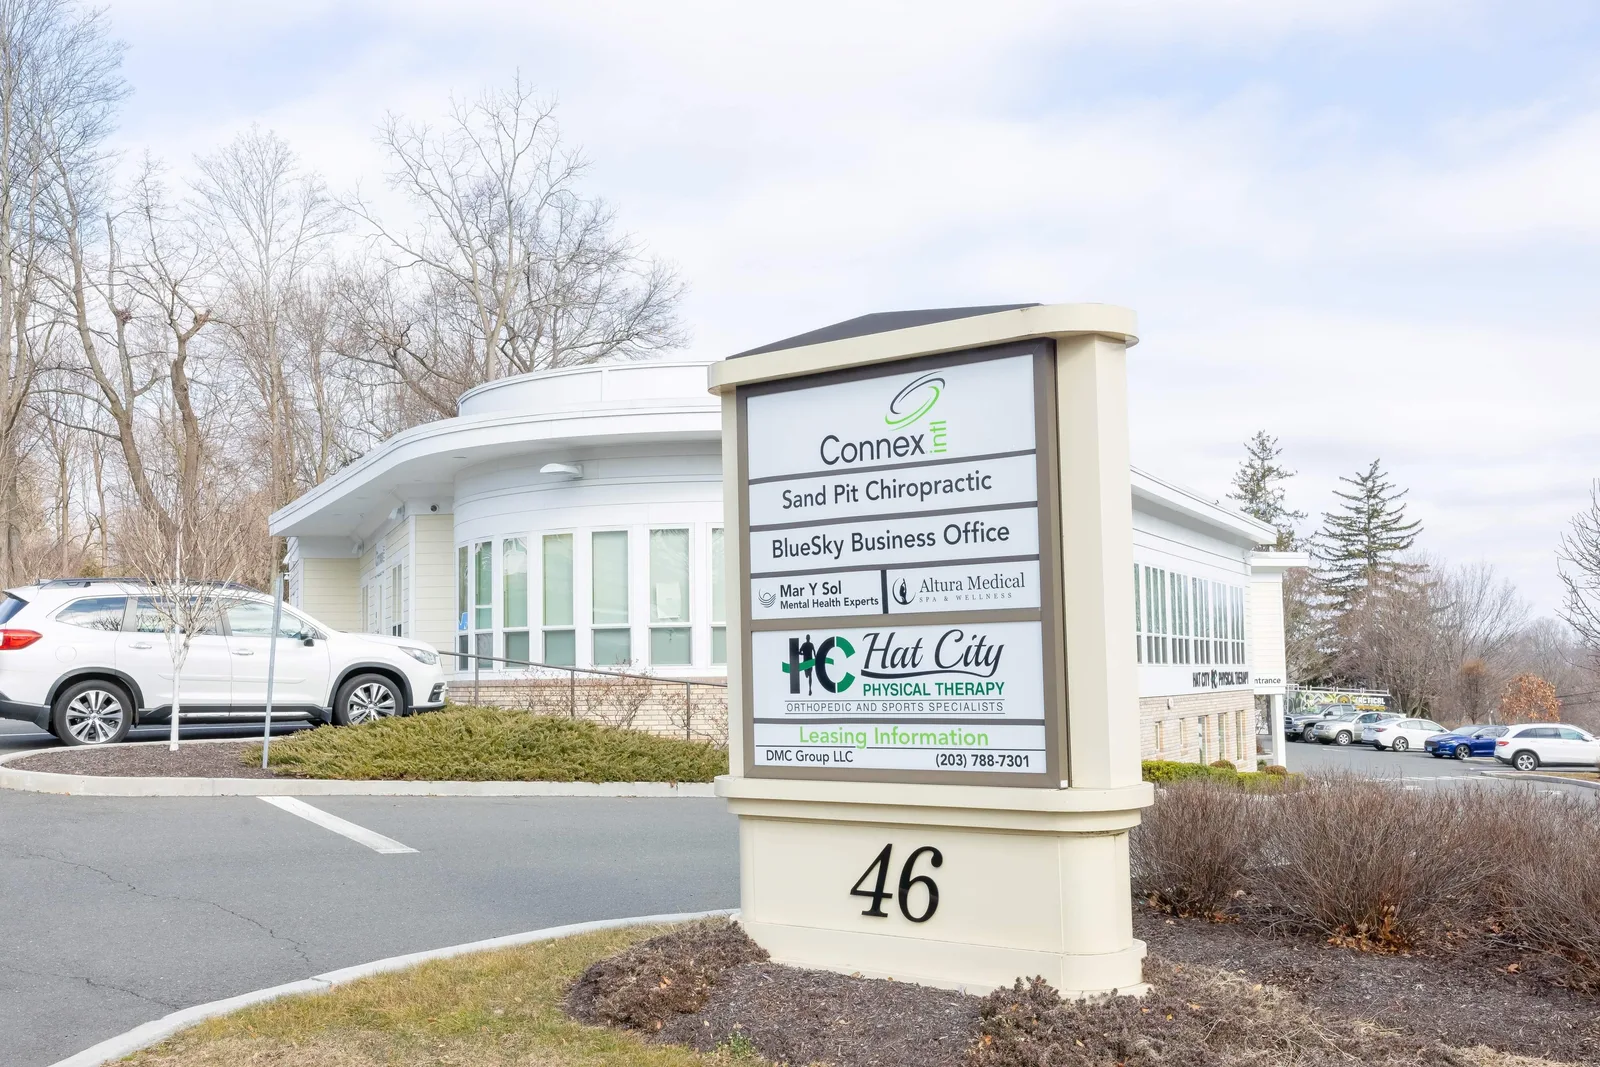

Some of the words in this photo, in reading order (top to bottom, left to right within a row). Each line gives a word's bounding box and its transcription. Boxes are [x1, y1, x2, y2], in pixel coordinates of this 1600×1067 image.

[820, 434, 925, 465] Connex
[782, 486, 826, 509] Sand
[834, 484, 858, 504] Pit
[866, 470, 992, 502] Chiropractic
[772, 534, 844, 558] BlueSky
[851, 530, 936, 552] Business
[943, 521, 1010, 545] Office
[780, 584, 805, 598] Mar
[808, 582, 818, 596] Y
[822, 580, 842, 595] Sol
[919, 578, 963, 592] Altura
[967, 572, 1025, 590] Medical
[780, 599, 810, 610] Mental
[812, 597, 840, 608] Health
[844, 596, 879, 608] Experts
[956, 592, 1012, 600] WELLNESS
[862, 632, 924, 670] Hat
[934, 629, 1004, 677] City
[863, 682, 931, 696] PHYSICAL
[935, 682, 1005, 696] THERAPY
[786, 702, 852, 712] ORTHOPEDIC
[856, 702, 877, 712] AND
[882, 702, 924, 712] SPORTS
[928, 702, 1004, 712] SPECIALISTS
[800, 726, 867, 749] Leasing
[874, 727, 988, 746] Information
[766, 750, 792, 762] DMC
[796, 751, 830, 765] Group
[834, 751, 854, 763] LLC
[936, 754, 967, 768] (203)
[972, 754, 1030, 768] 788-7301
[850, 843, 944, 923] 46
